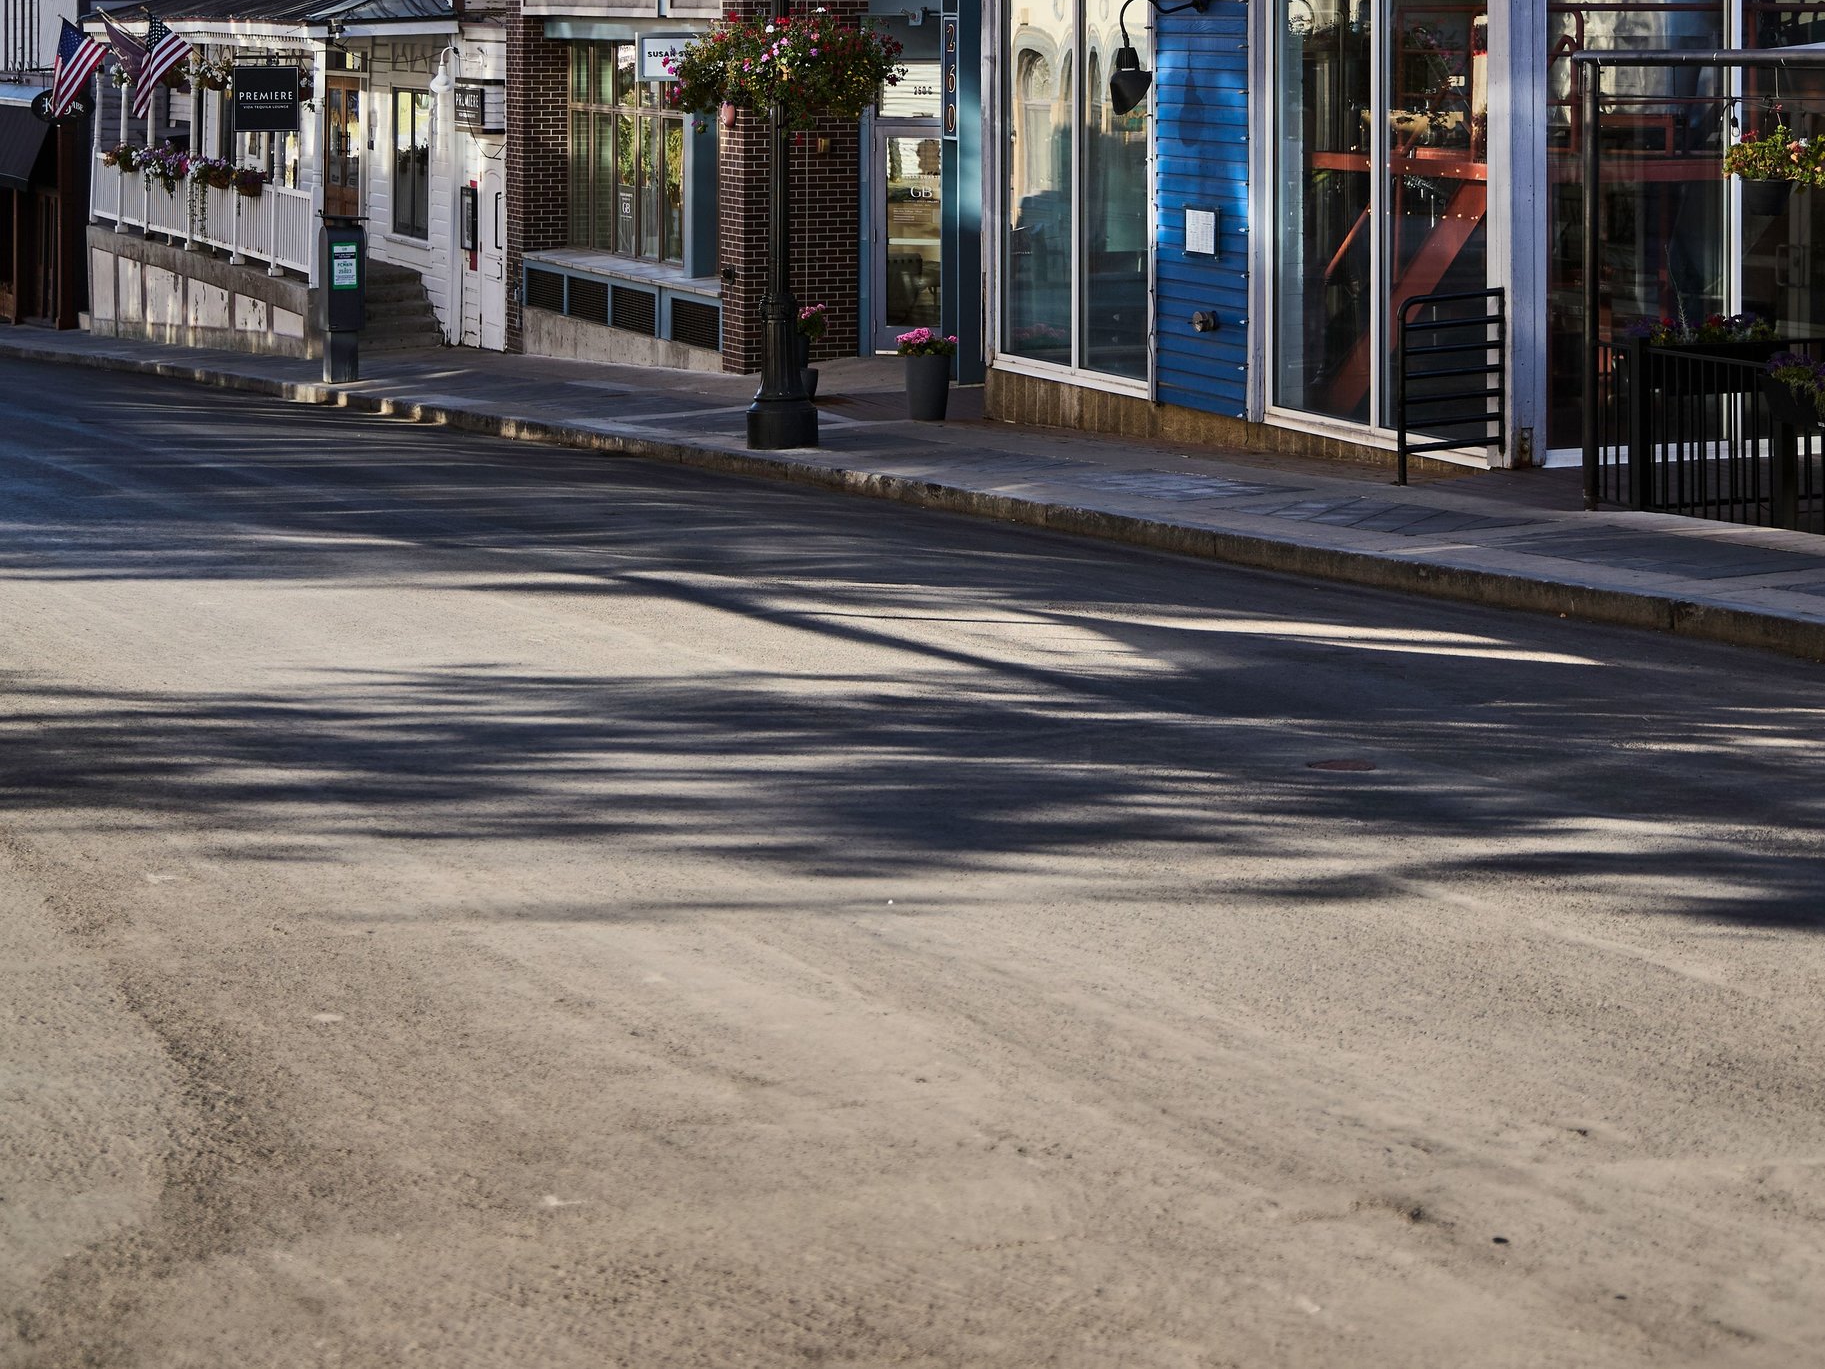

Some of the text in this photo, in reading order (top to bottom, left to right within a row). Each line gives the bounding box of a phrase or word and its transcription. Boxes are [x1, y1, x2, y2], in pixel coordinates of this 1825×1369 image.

[946, 23, 956, 133] 260
[239, 92, 293, 100] PREMIERE
[455, 92, 479, 108] PREMIERE
[910, 185, 933, 198] GB
